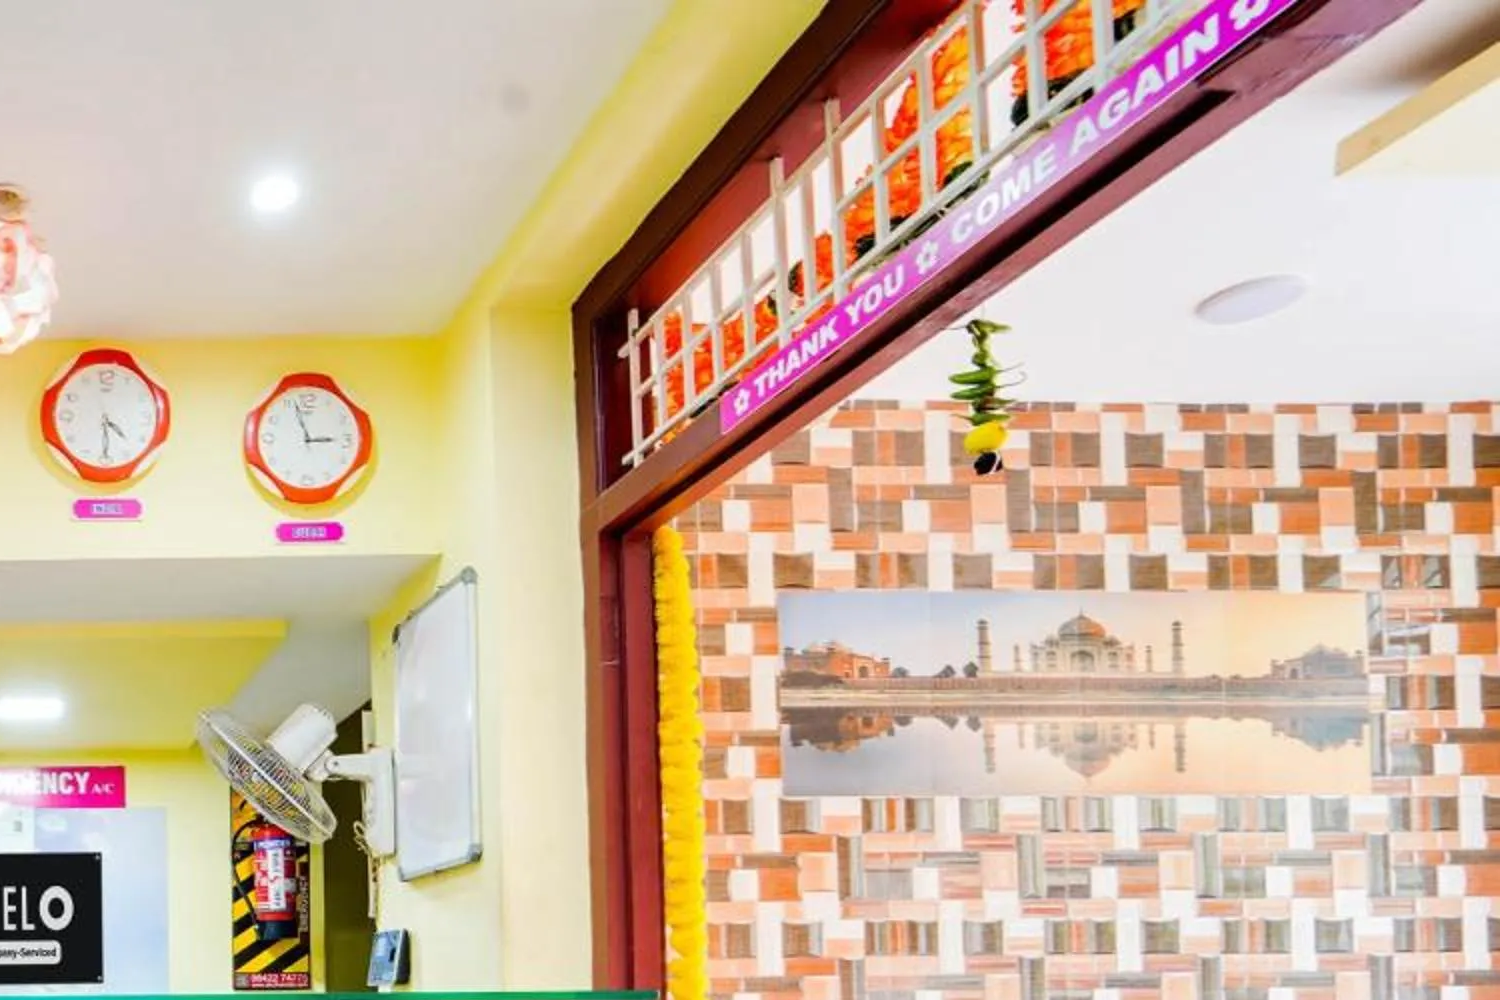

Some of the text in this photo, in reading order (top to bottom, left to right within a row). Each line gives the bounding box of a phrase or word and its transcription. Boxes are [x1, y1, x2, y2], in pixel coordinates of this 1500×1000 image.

[754, 15, 1221, 397] THANK YOU COME AGAIN
